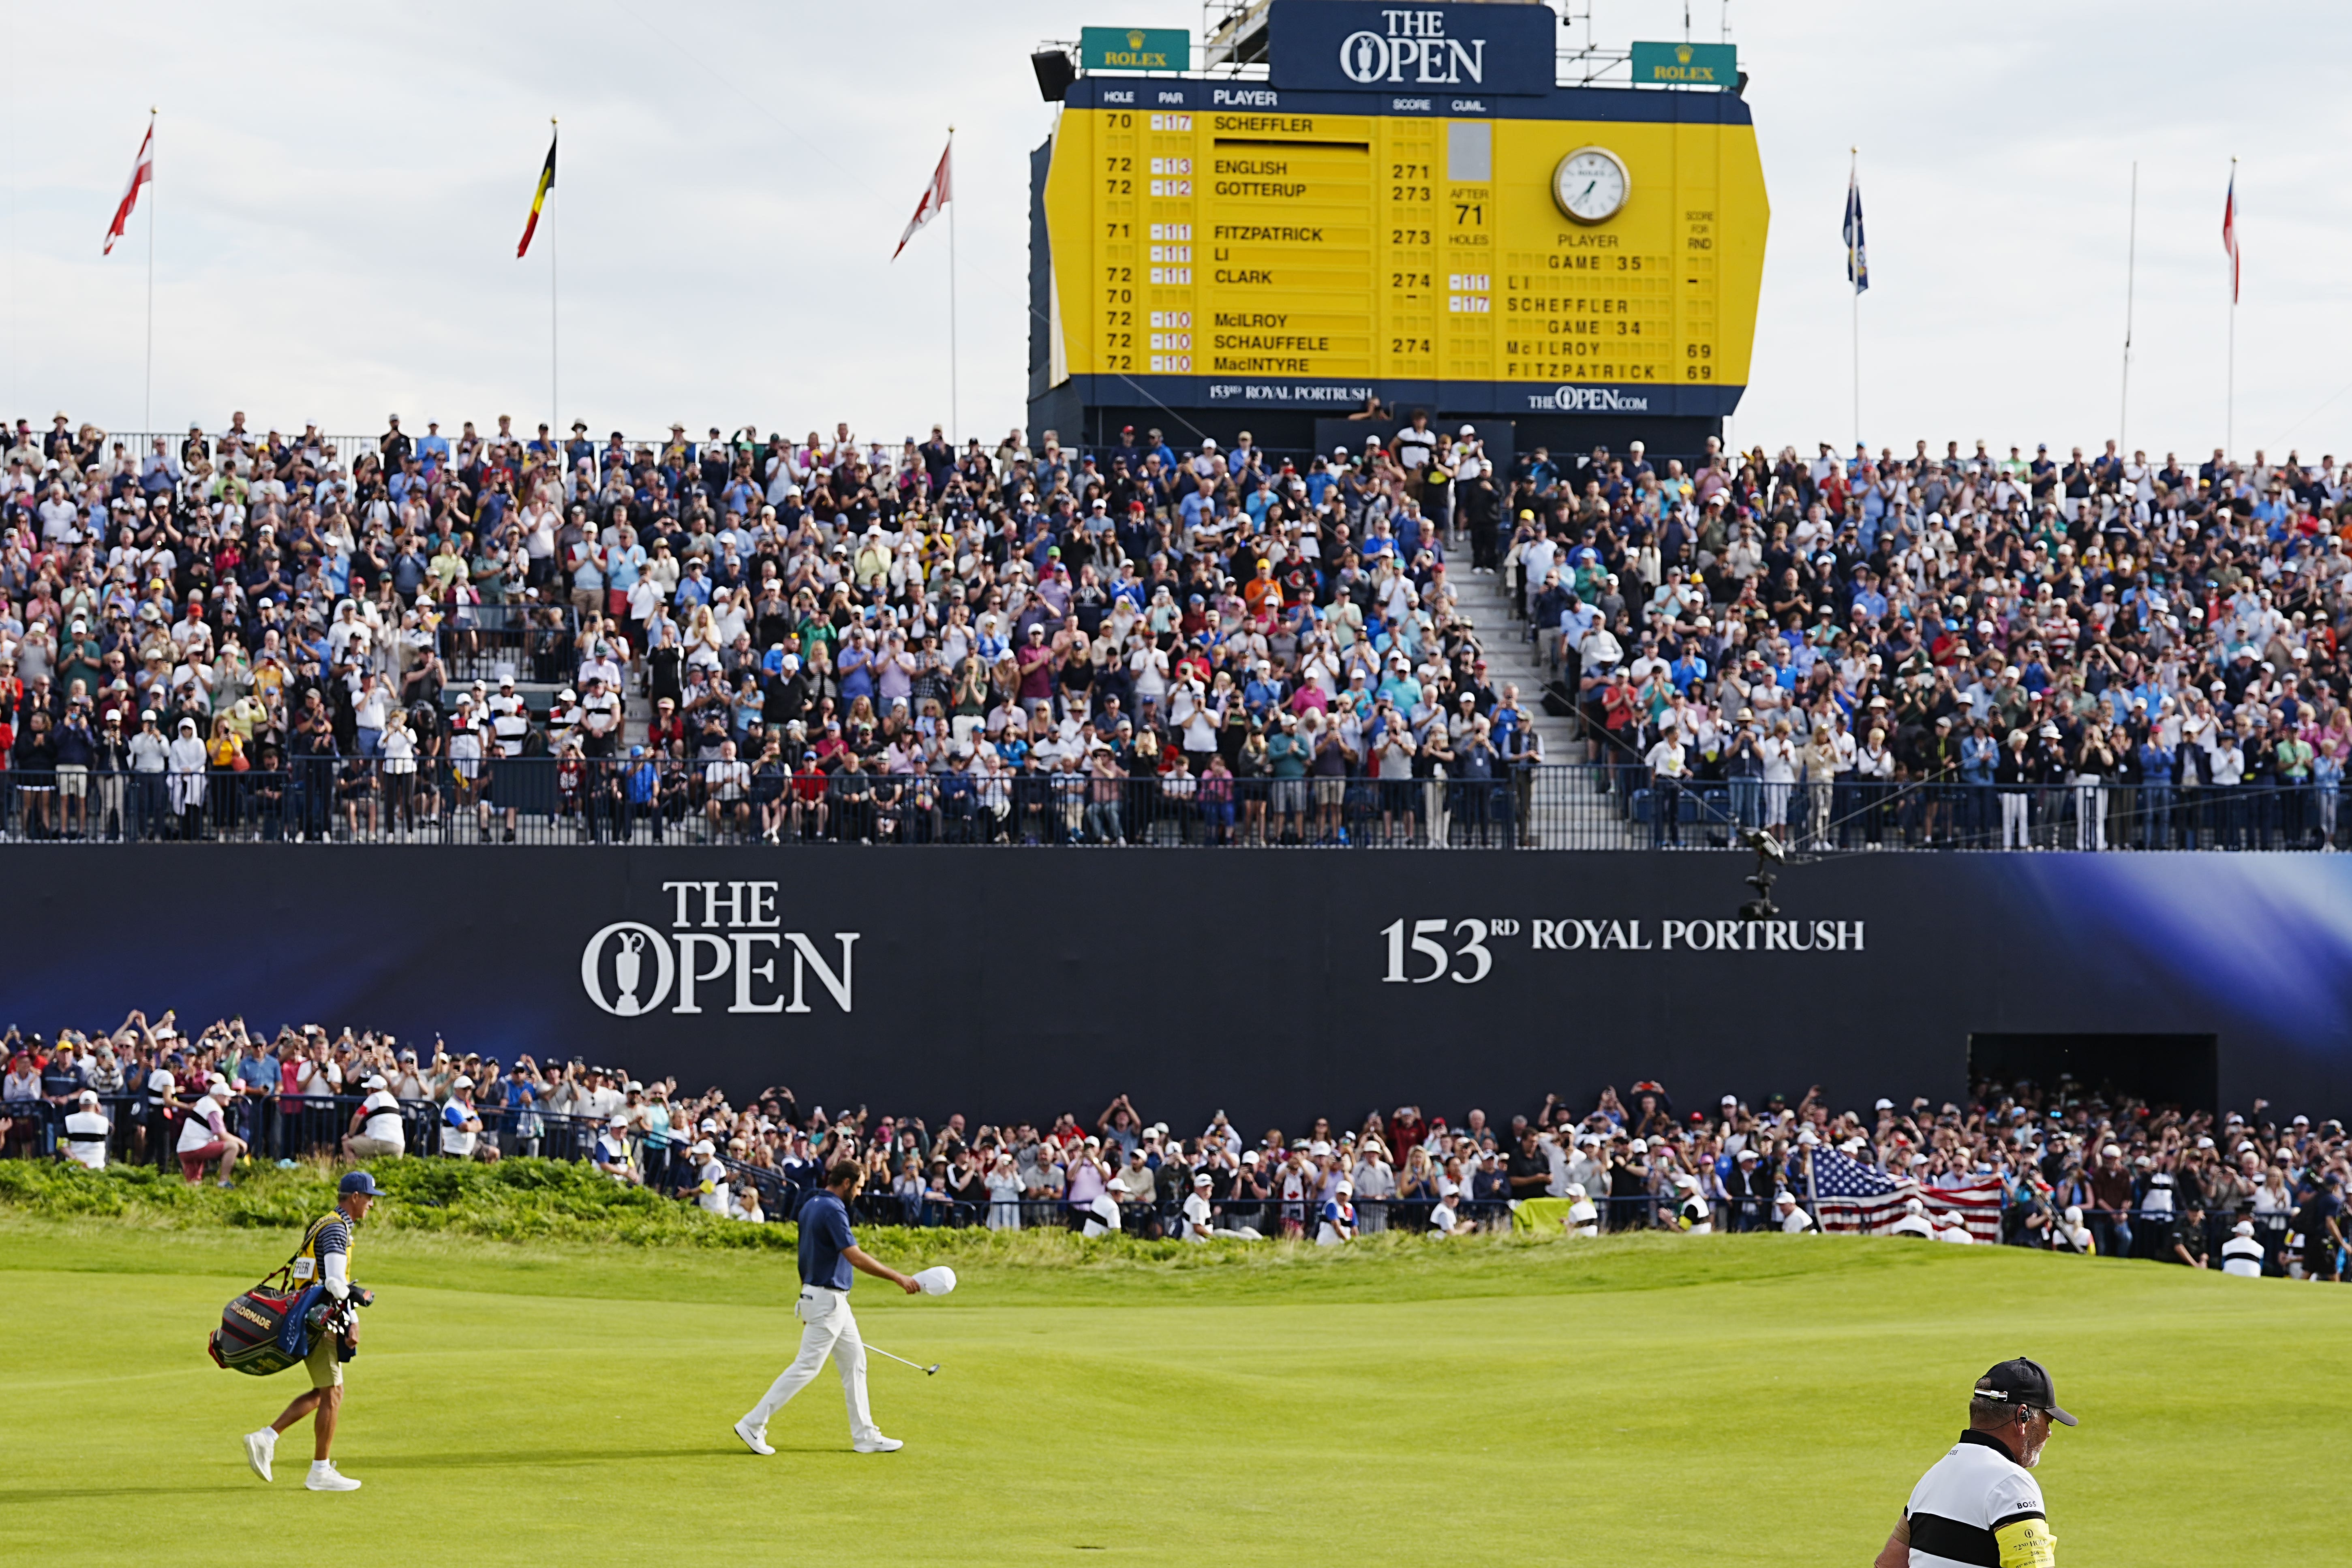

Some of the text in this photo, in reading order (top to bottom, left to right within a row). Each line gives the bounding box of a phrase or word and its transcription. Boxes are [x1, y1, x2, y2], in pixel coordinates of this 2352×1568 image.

[1382, 10, 1444, 37] THE
[1104, 52, 1166, 67] ROLEX
[1340, 31, 1486, 83] OPEN
[1654, 66, 1714, 81] ROLEX
[1104, 91, 1134, 103] HOLE
[1158, 92, 1183, 104] PAR
[1215, 90, 1277, 106] PLAYER
[1393, 99, 1431, 111] SCORE
[1107, 114, 1313, 133] 70 -17 SCHEFFLER
[1107, 158, 1431, 179] 72 -13 ENGLISH 271
[1107, 180, 1431, 201] 72 -12 GOTTERUP 273
[1450, 188, 1489, 200] AFTER
[1455, 205, 1482, 226] 71
[1685, 211, 1714, 221] SCORE
[1107, 225, 1431, 244] 71 -11 FITZPATRICK 273
[1691, 225, 1709, 234] FOR
[1449, 234, 1488, 246] HOLES
[1558, 234, 1618, 248] PLAYER
[1688, 237, 1712, 250] RND
[1154, 246, 1229, 261] -11 LI
[1549, 256, 1641, 270] GAME 35
[1107, 268, 1431, 288] 72 -11 CLARK 274
[1452, 275, 1488, 290] -11
[1509, 276, 1530, 289] LI
[1107, 290, 1131, 304] 70
[1452, 297, 1628, 313] -17 SCHEFFLER
[1107, 312, 1287, 328] 72 -10 McILROY
[1549, 321, 1641, 335] GAME 34
[1107, 334, 1431, 353] 72 -10 SCHAUFFELE 274
[1507, 341, 1711, 358] McILROY 69
[1107, 355, 1309, 372] 72 -10 MacINTYRE
[1508, 363, 1711, 379] FITZPATRICK 69
[1246, 385, 1293, 400] ROYAL
[1295, 386, 1373, 401] PORTRUSH
[662, 881, 781, 927] THE
[1380, 918, 1864, 983] 153RD ROYAL PORTRUSH
[581, 921, 860, 1016] OPEN
[230, 1301, 272, 1331] TAYLORMADE
[2017, 1501, 2036, 1509] BOSS
